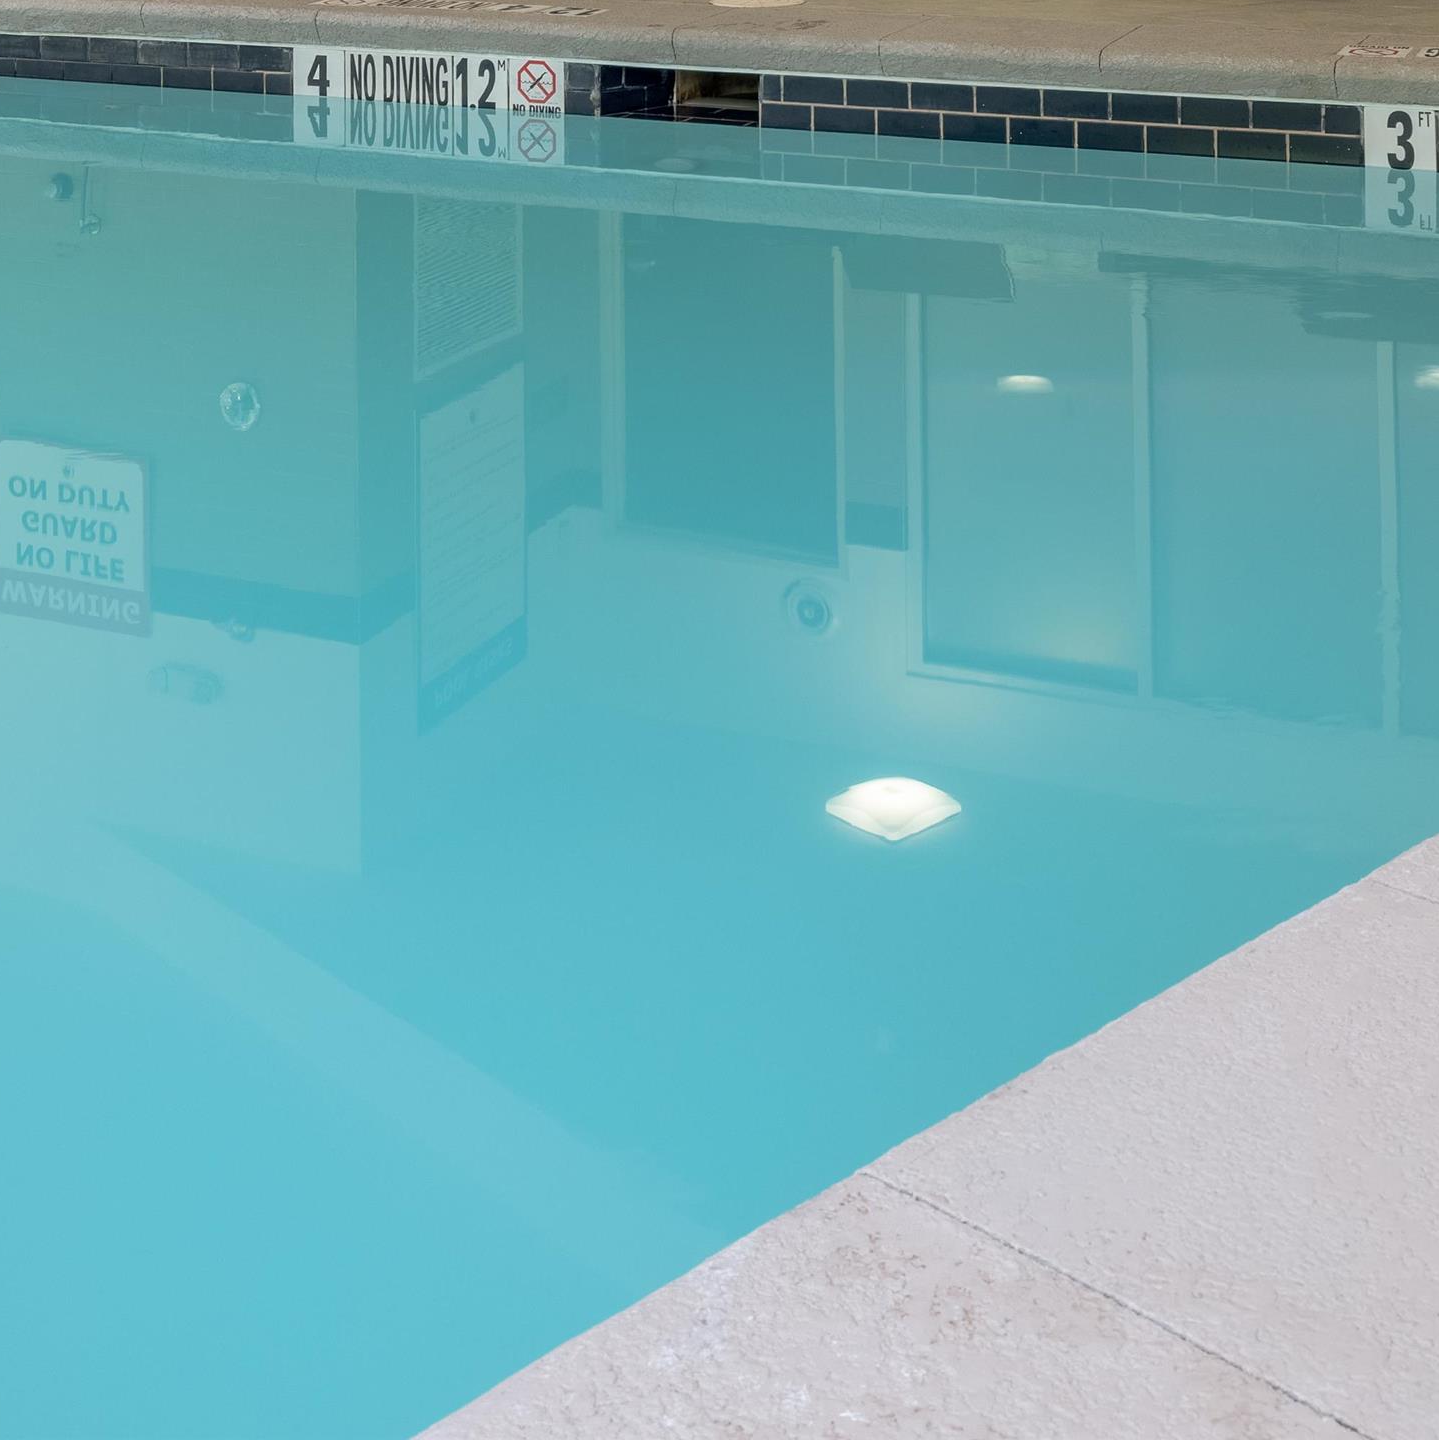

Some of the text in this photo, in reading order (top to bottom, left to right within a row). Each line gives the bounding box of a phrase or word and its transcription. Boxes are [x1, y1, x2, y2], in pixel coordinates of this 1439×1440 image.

[307, 53, 506, 110] 4 NO DIVING 1.2 M
[513, 104, 561, 114] NO DIVING
[1386, 110, 1415, 170] 3
[1418, 111, 1431, 128] FT
